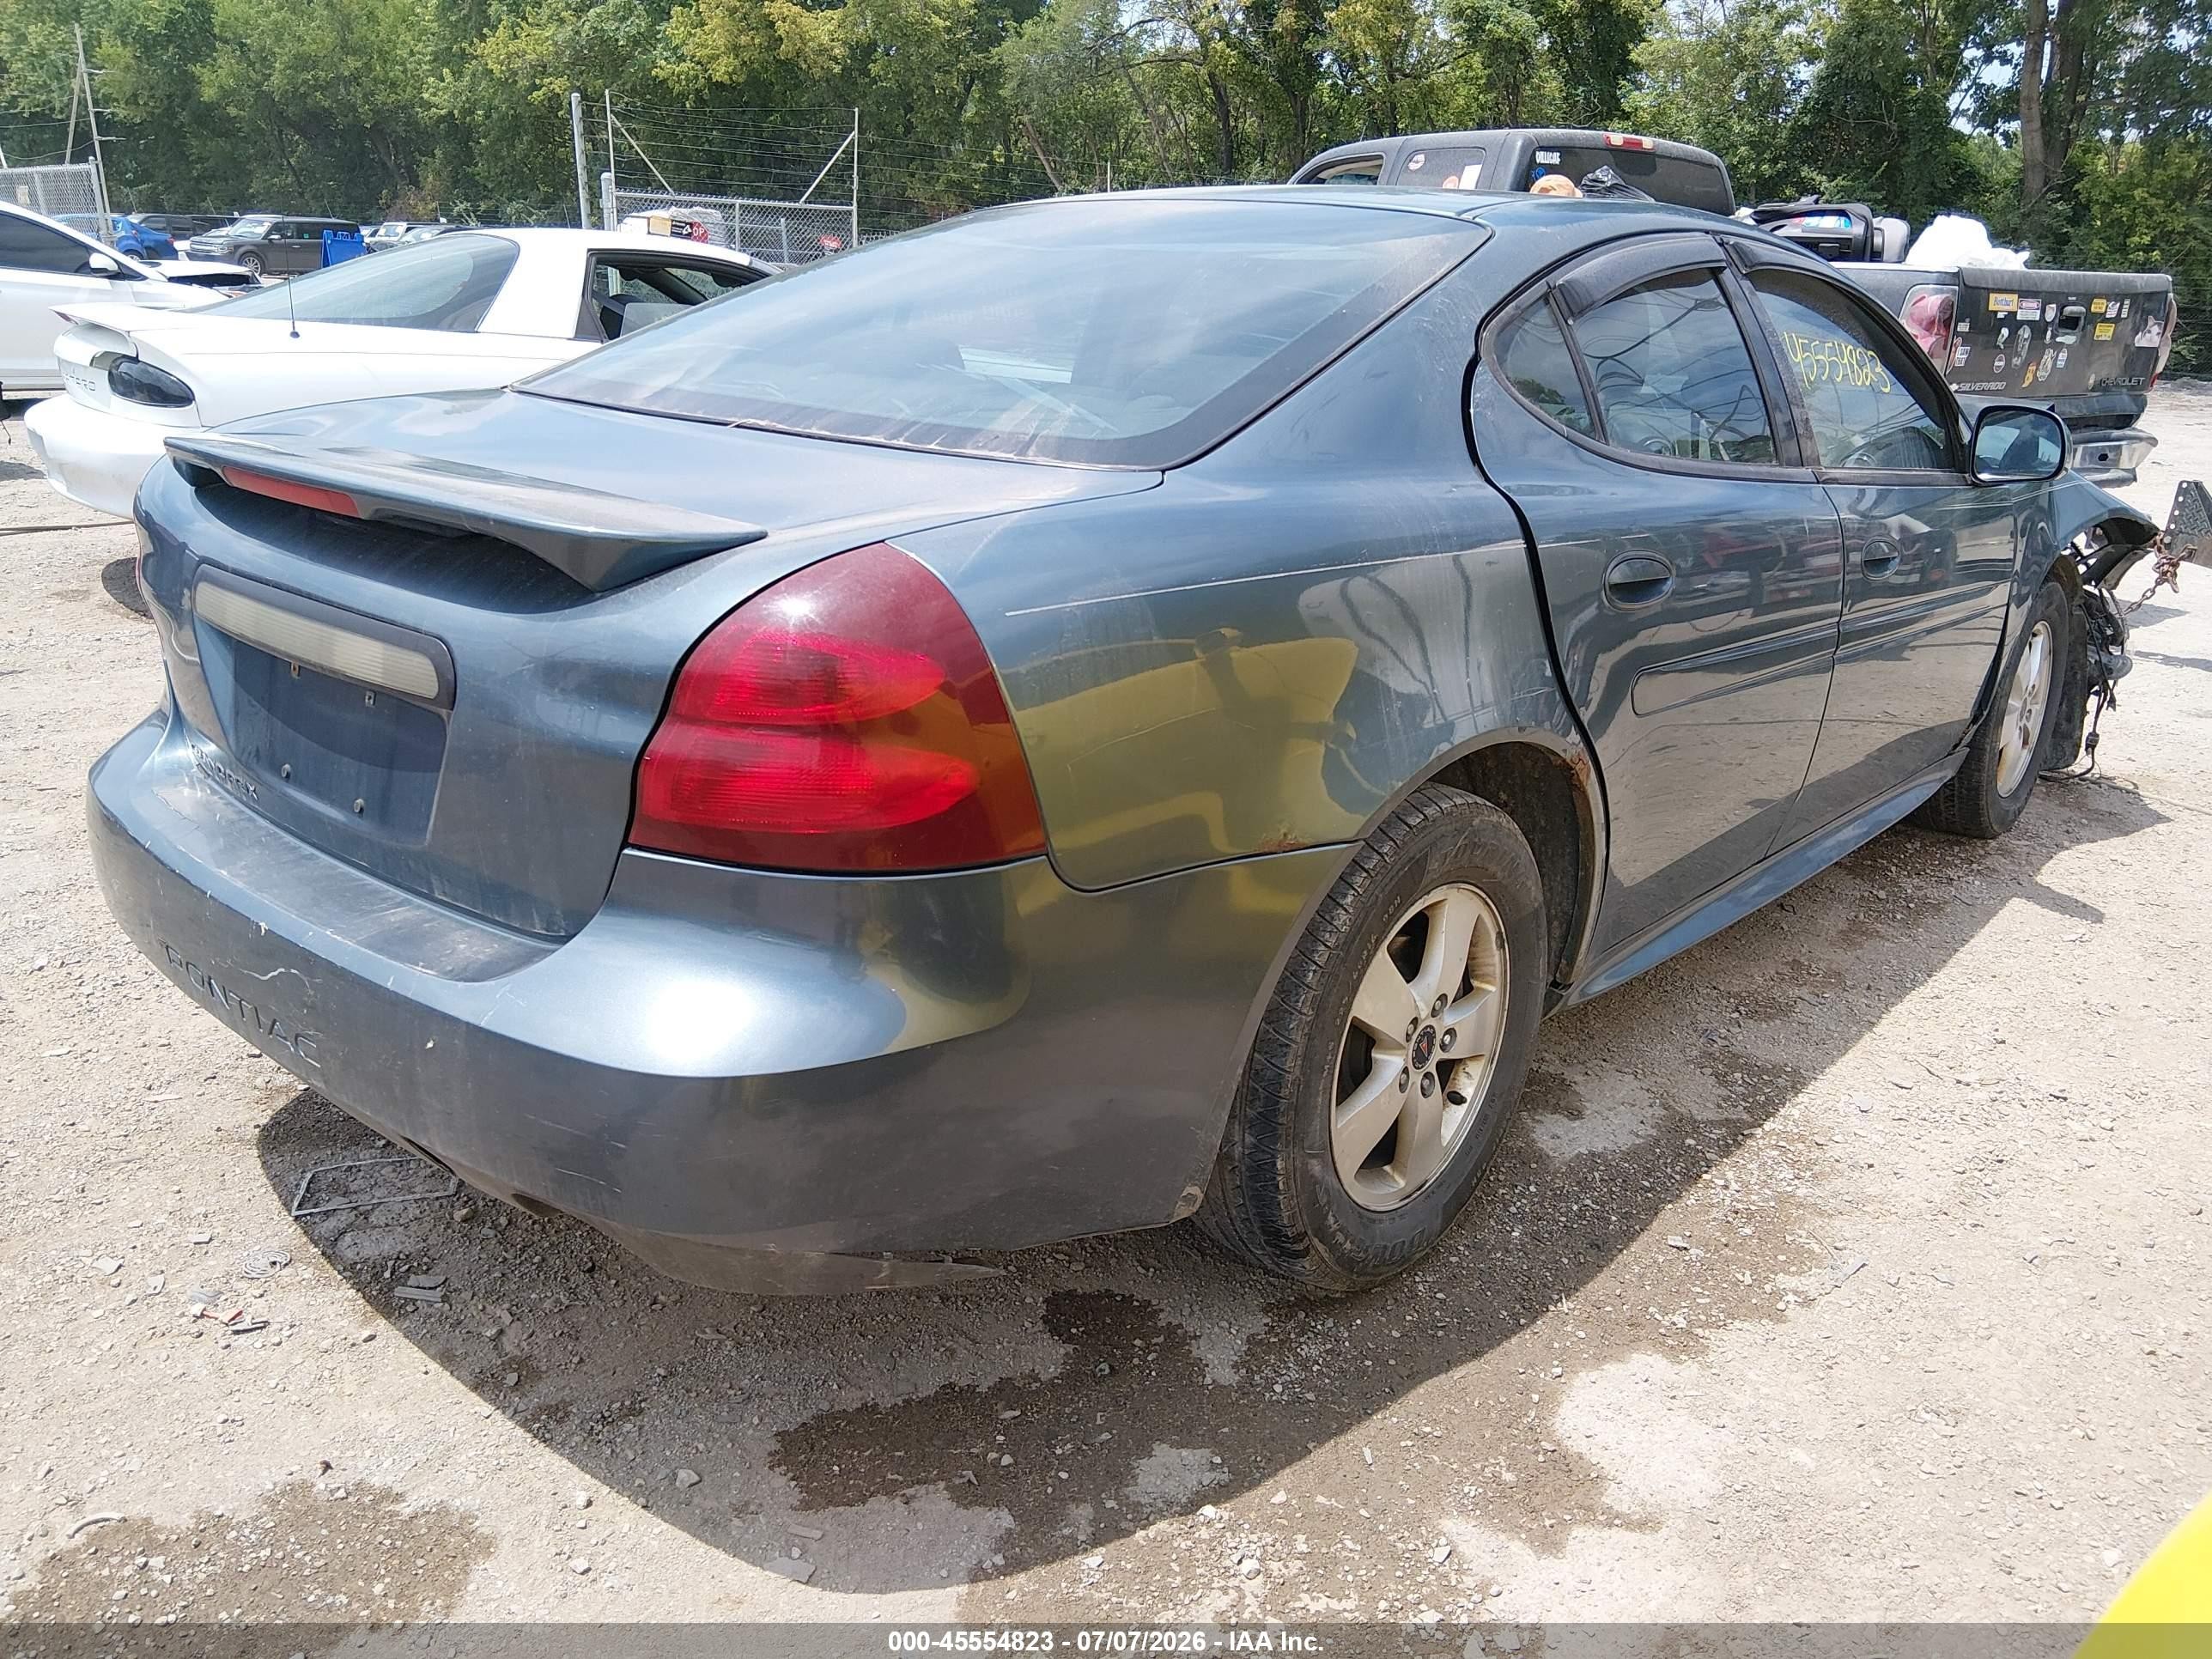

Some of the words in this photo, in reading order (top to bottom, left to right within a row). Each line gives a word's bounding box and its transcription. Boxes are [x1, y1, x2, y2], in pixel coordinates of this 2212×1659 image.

[692, 227, 705, 236] OP
[1784, 331, 1891, 393] 45554823
[2101, 377, 2146, 386] CHEVROLET
[1958, 382, 2007, 391] SILVERADO
[159, 938, 321, 1068] PONTIAC
